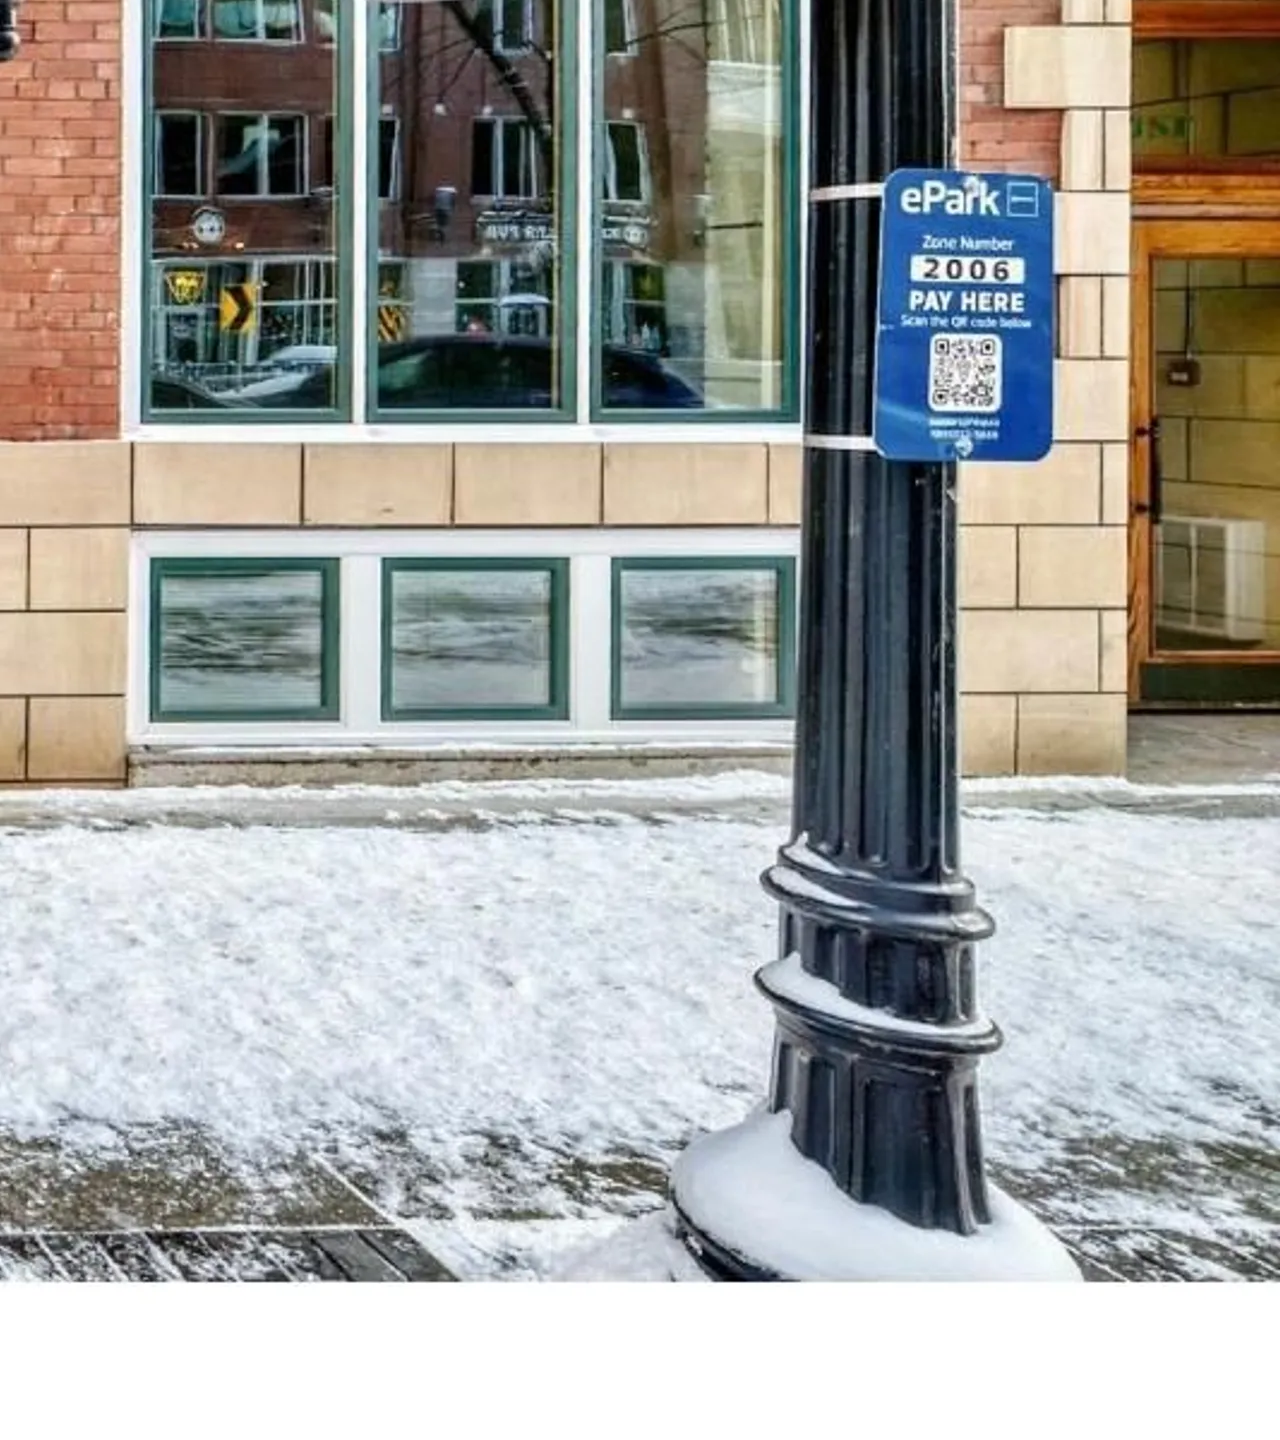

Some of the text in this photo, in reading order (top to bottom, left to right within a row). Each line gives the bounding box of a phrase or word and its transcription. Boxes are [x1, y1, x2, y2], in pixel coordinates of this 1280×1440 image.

[900, 179, 1001, 216] ePark
[922, 234, 1015, 252] Zone Number
[923, 259, 1009, 281] 2006
[909, 290, 1025, 313] PAY HERE
[900, 314, 928, 327] Scan
[930, 315, 948, 327] the
[970, 317, 997, 328] code
[1000, 316, 1032, 329] below
